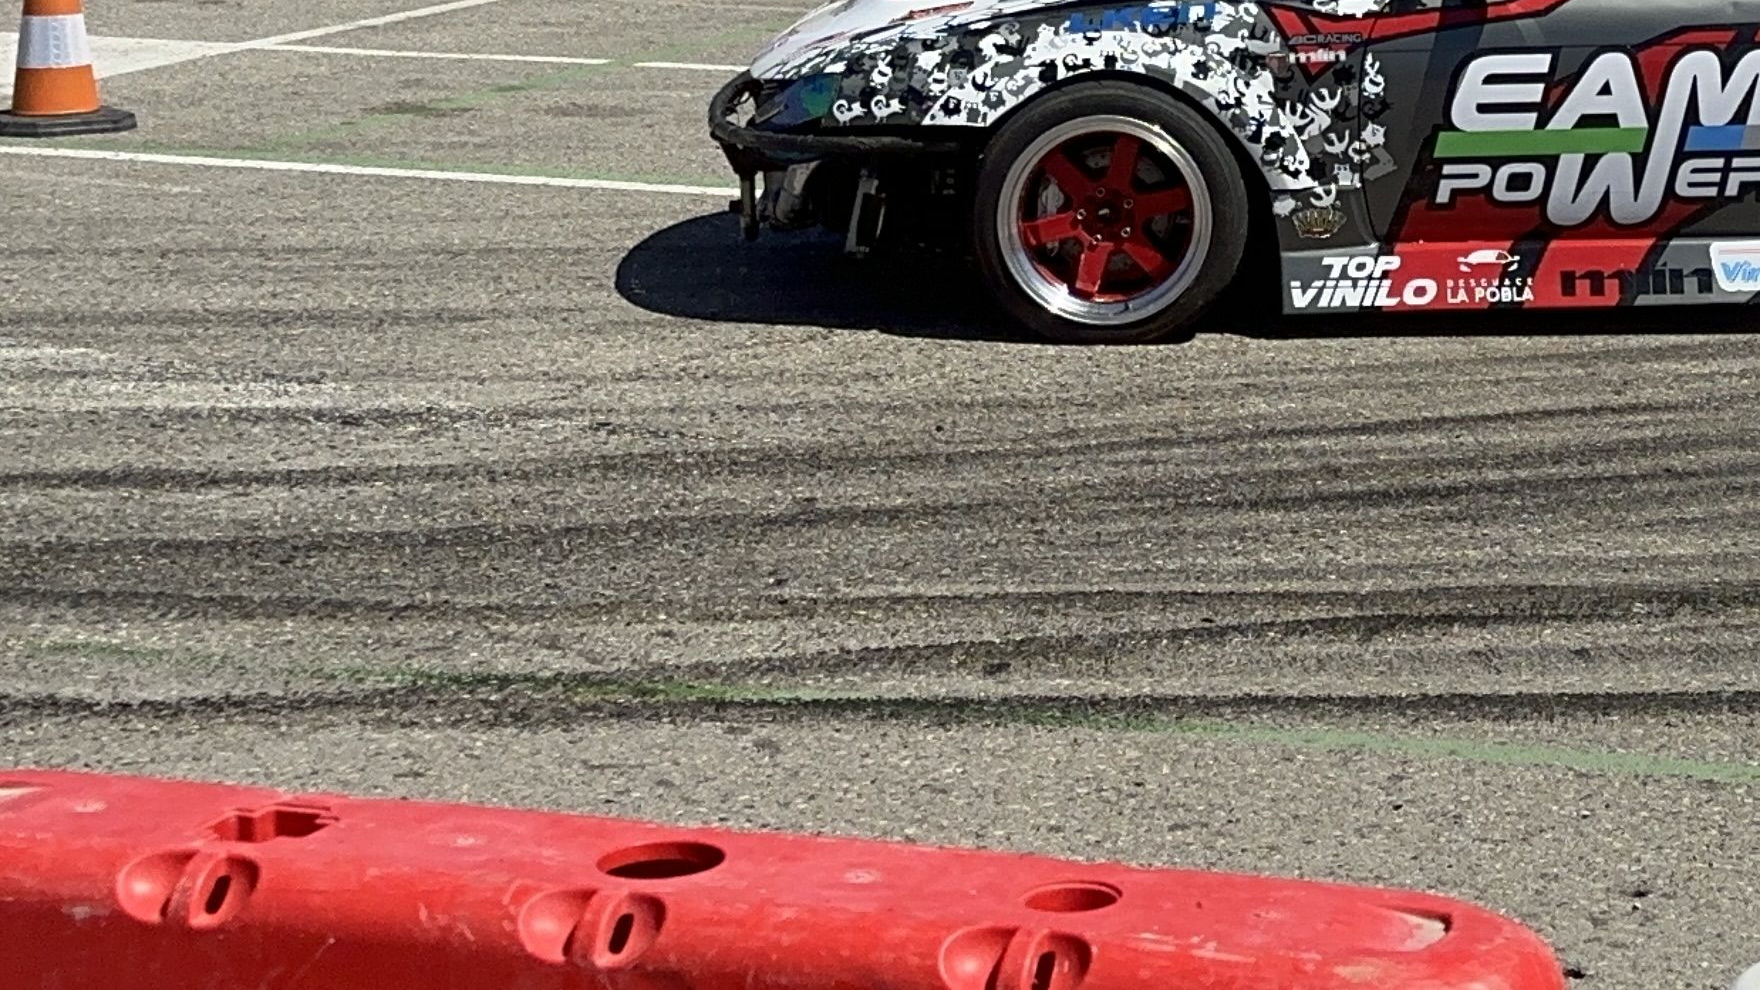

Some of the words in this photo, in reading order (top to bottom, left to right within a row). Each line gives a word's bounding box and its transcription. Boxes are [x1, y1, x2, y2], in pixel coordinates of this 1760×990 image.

[1322, 256, 1401, 278] TOP
[1447, 288, 1469, 304] LA
[1474, 286, 1534, 303] POBLA
